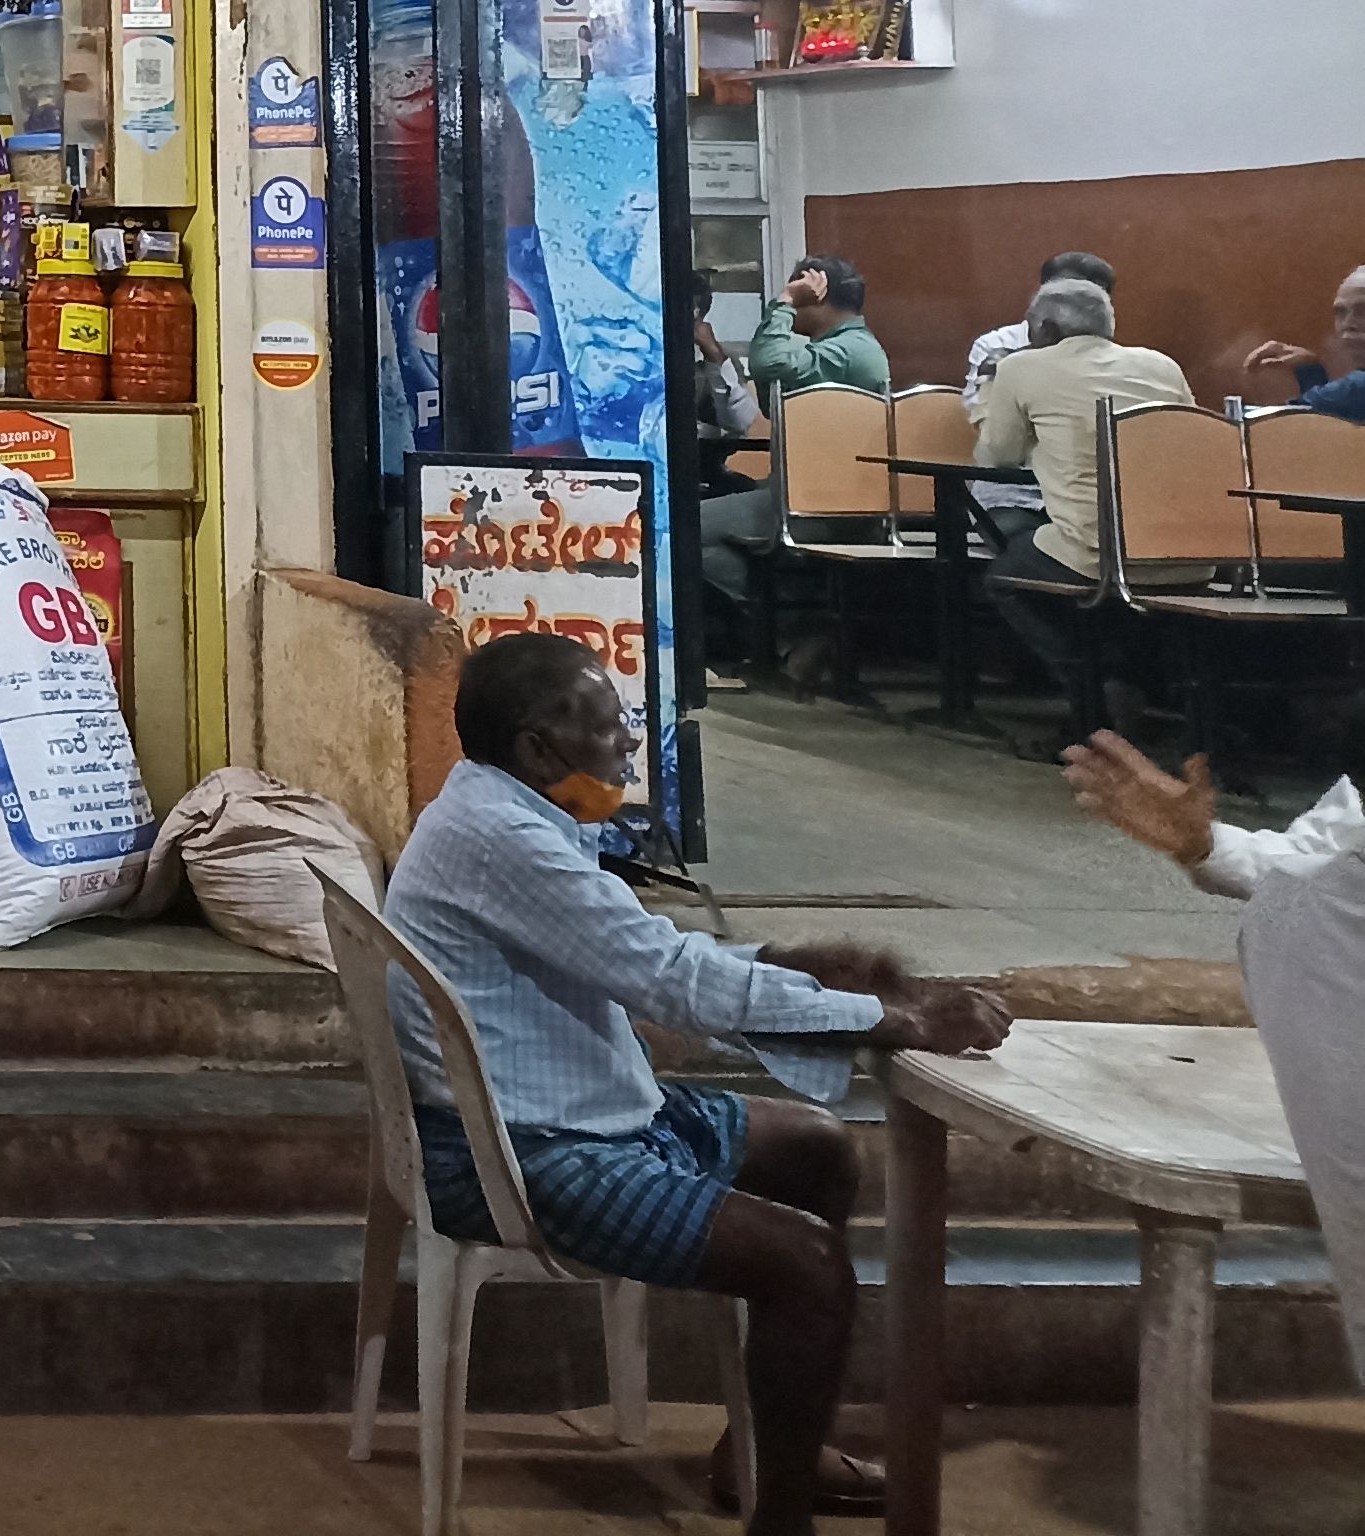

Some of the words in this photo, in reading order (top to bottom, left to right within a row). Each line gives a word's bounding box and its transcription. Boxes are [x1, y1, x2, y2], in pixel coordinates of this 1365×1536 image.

[272, 68, 291, 96] पे
[256, 107, 312, 120] PhonePe
[274, 187, 293, 216] पे
[257, 225, 313, 240] PhonePe
[416, 369, 562, 429] PSI
[32, 430, 57, 444] pay
[19, 581, 98, 647] GB
[0, 791, 24, 823] GB
[52, 842, 78, 861] GB
